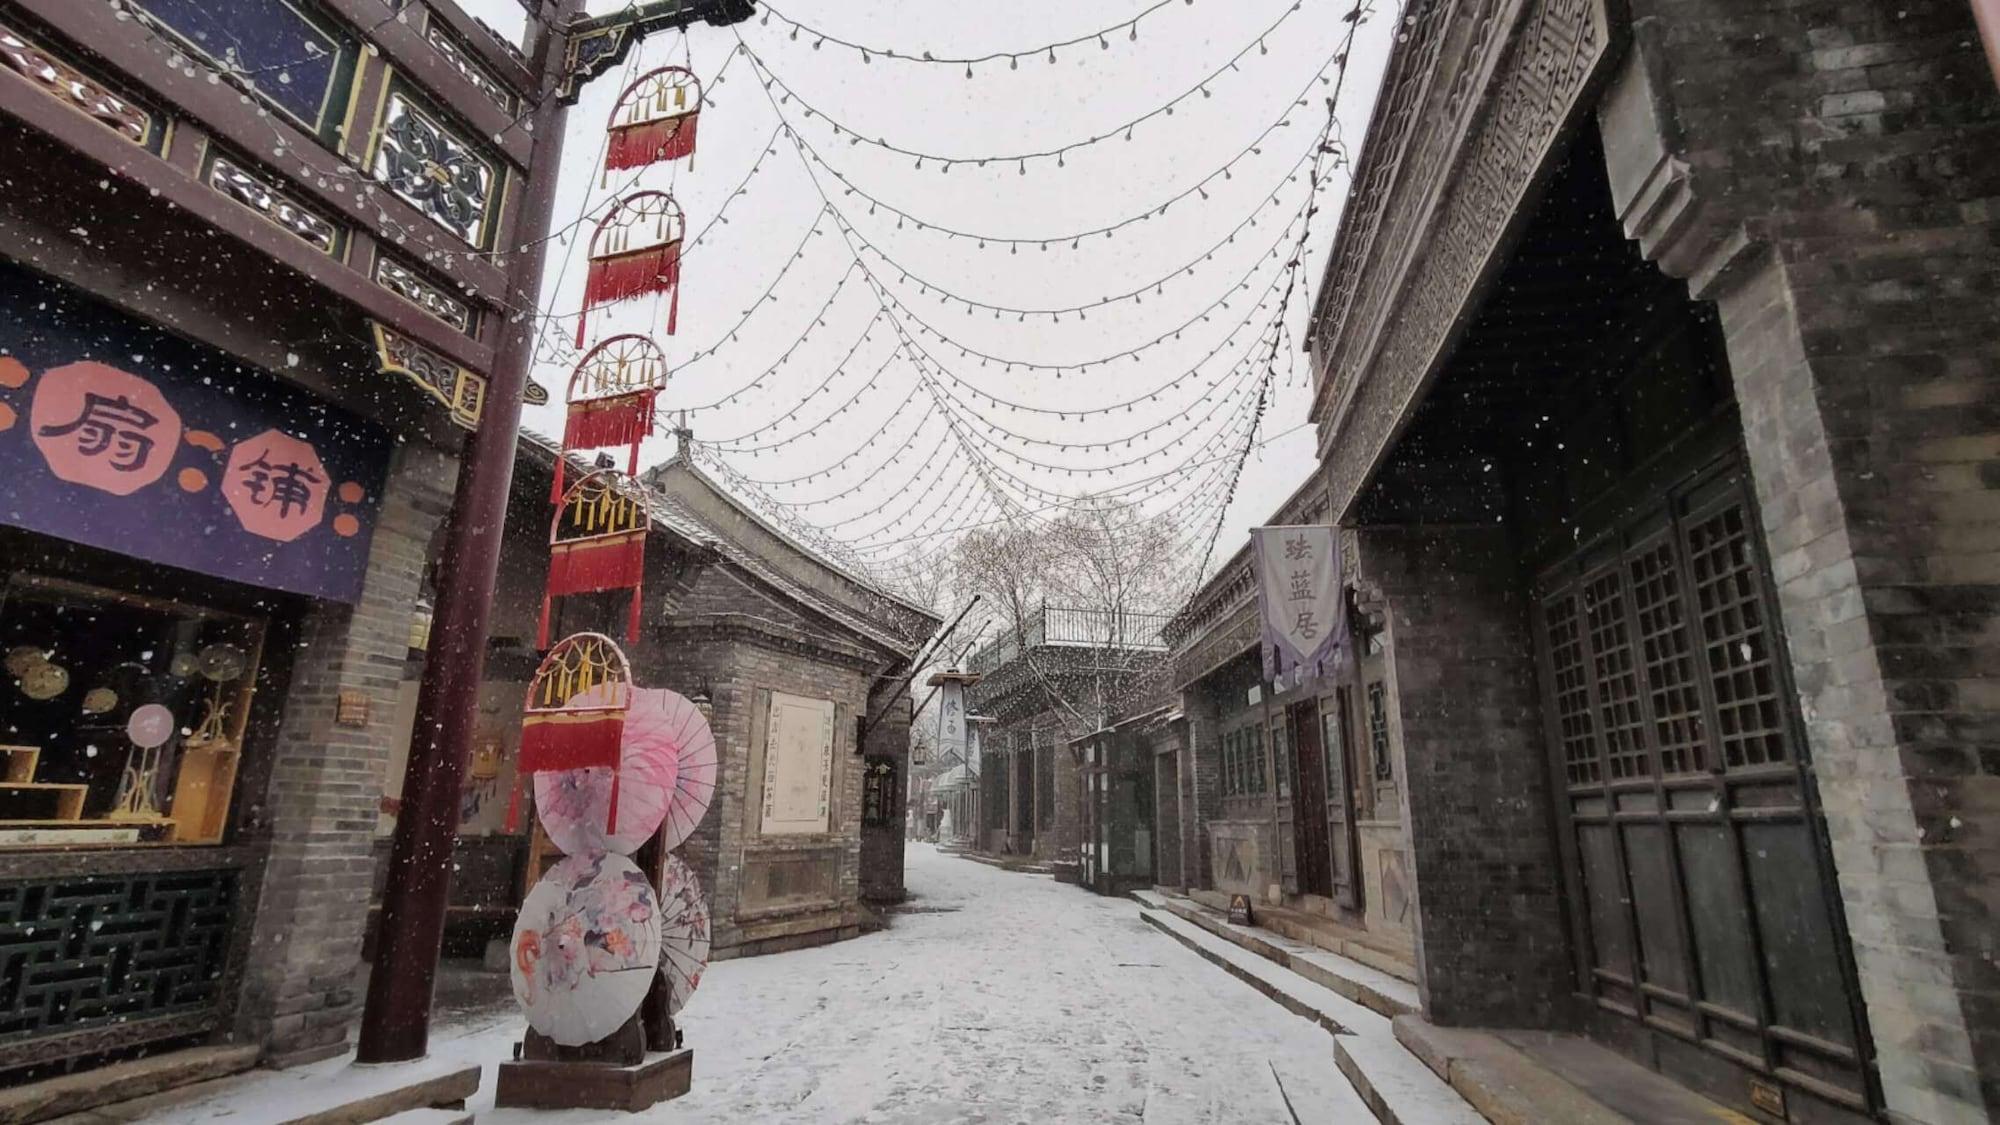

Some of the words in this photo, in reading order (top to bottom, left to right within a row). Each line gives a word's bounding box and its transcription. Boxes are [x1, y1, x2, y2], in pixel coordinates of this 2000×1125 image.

[38, 391, 322, 519] 扇铺
[1284, 532, 1319, 640] 珐蓝居
